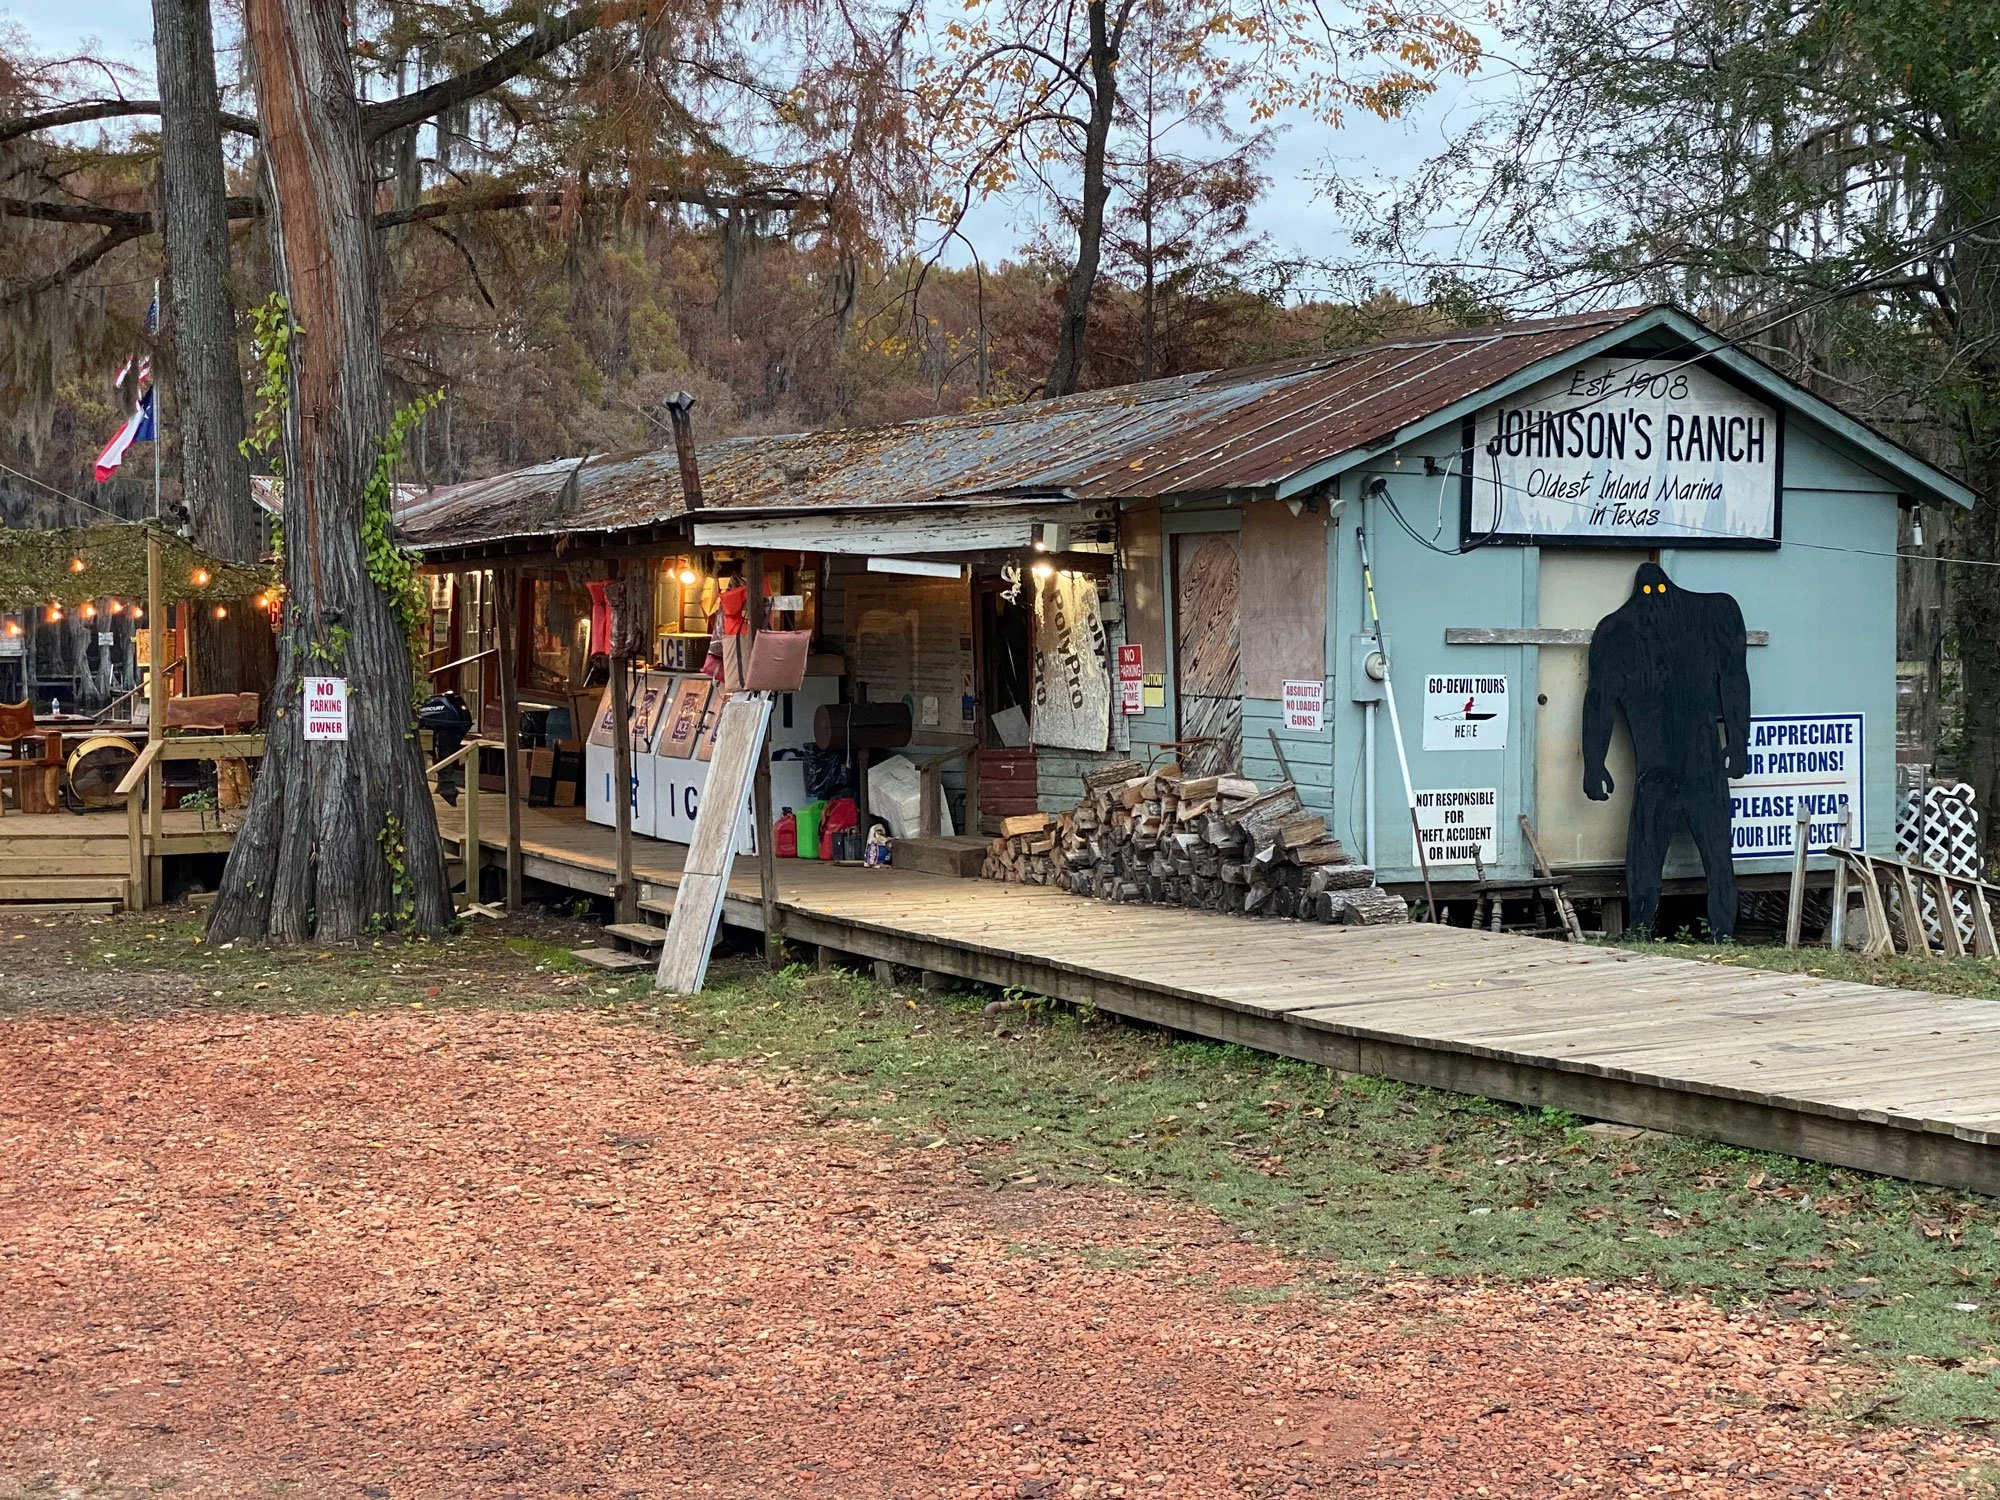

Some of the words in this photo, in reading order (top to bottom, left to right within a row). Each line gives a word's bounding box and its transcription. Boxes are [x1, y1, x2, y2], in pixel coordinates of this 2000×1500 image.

[1567, 369, 1615, 396] Est
[1625, 370, 1689, 400] 1908
[1486, 407, 1653, 461] JOHNSON'S
[1666, 413, 1765, 463] RANCH
[1527, 468, 1594, 498] Oldest
[1599, 468, 1652, 500] Inland
[1655, 473, 1724, 502] Marina
[1589, 502, 1608, 526] in
[1612, 502, 1661, 529] Texas
[660, 638, 684, 668] ICE
[1124, 649, 1135, 662] NO
[1120, 664, 1142, 678] PARKING
[1124, 682, 1138, 691] ANY
[1143, 673, 1163, 686] AUTION
[1429, 678, 1474, 694] GO-DEVIL
[1475, 678, 1505, 694] TOURS
[316, 683, 334, 696] NO
[1123, 692, 1139, 701] TIME
[310, 699, 342, 712] PARKING
[1286, 699, 1295, 711] NO
[1296, 700, 1320, 712] LOADED
[310, 721, 342, 733] OWNER
[1291, 714, 1316, 727] GUNS!
[1454, 724, 1478, 738] HERE
[1755, 723, 1853, 747] APPRECIATE
[1746, 753, 1764, 775] UR
[1768, 751, 1844, 774] PATRONS!
[670, 783, 698, 821] IC
[1416, 793, 1434, 807] NOT
[1436, 791, 1494, 807] RESPONSIBLE
[1730, 796, 1794, 819] PLEASE
[1444, 810, 1464, 824] FOR
[1418, 828, 1445, 843] HEFT,
[1446, 826, 1492, 842] ACCIDENT
[1767, 825, 1792, 847] LIFE
[1429, 847, 1443, 860] OR
